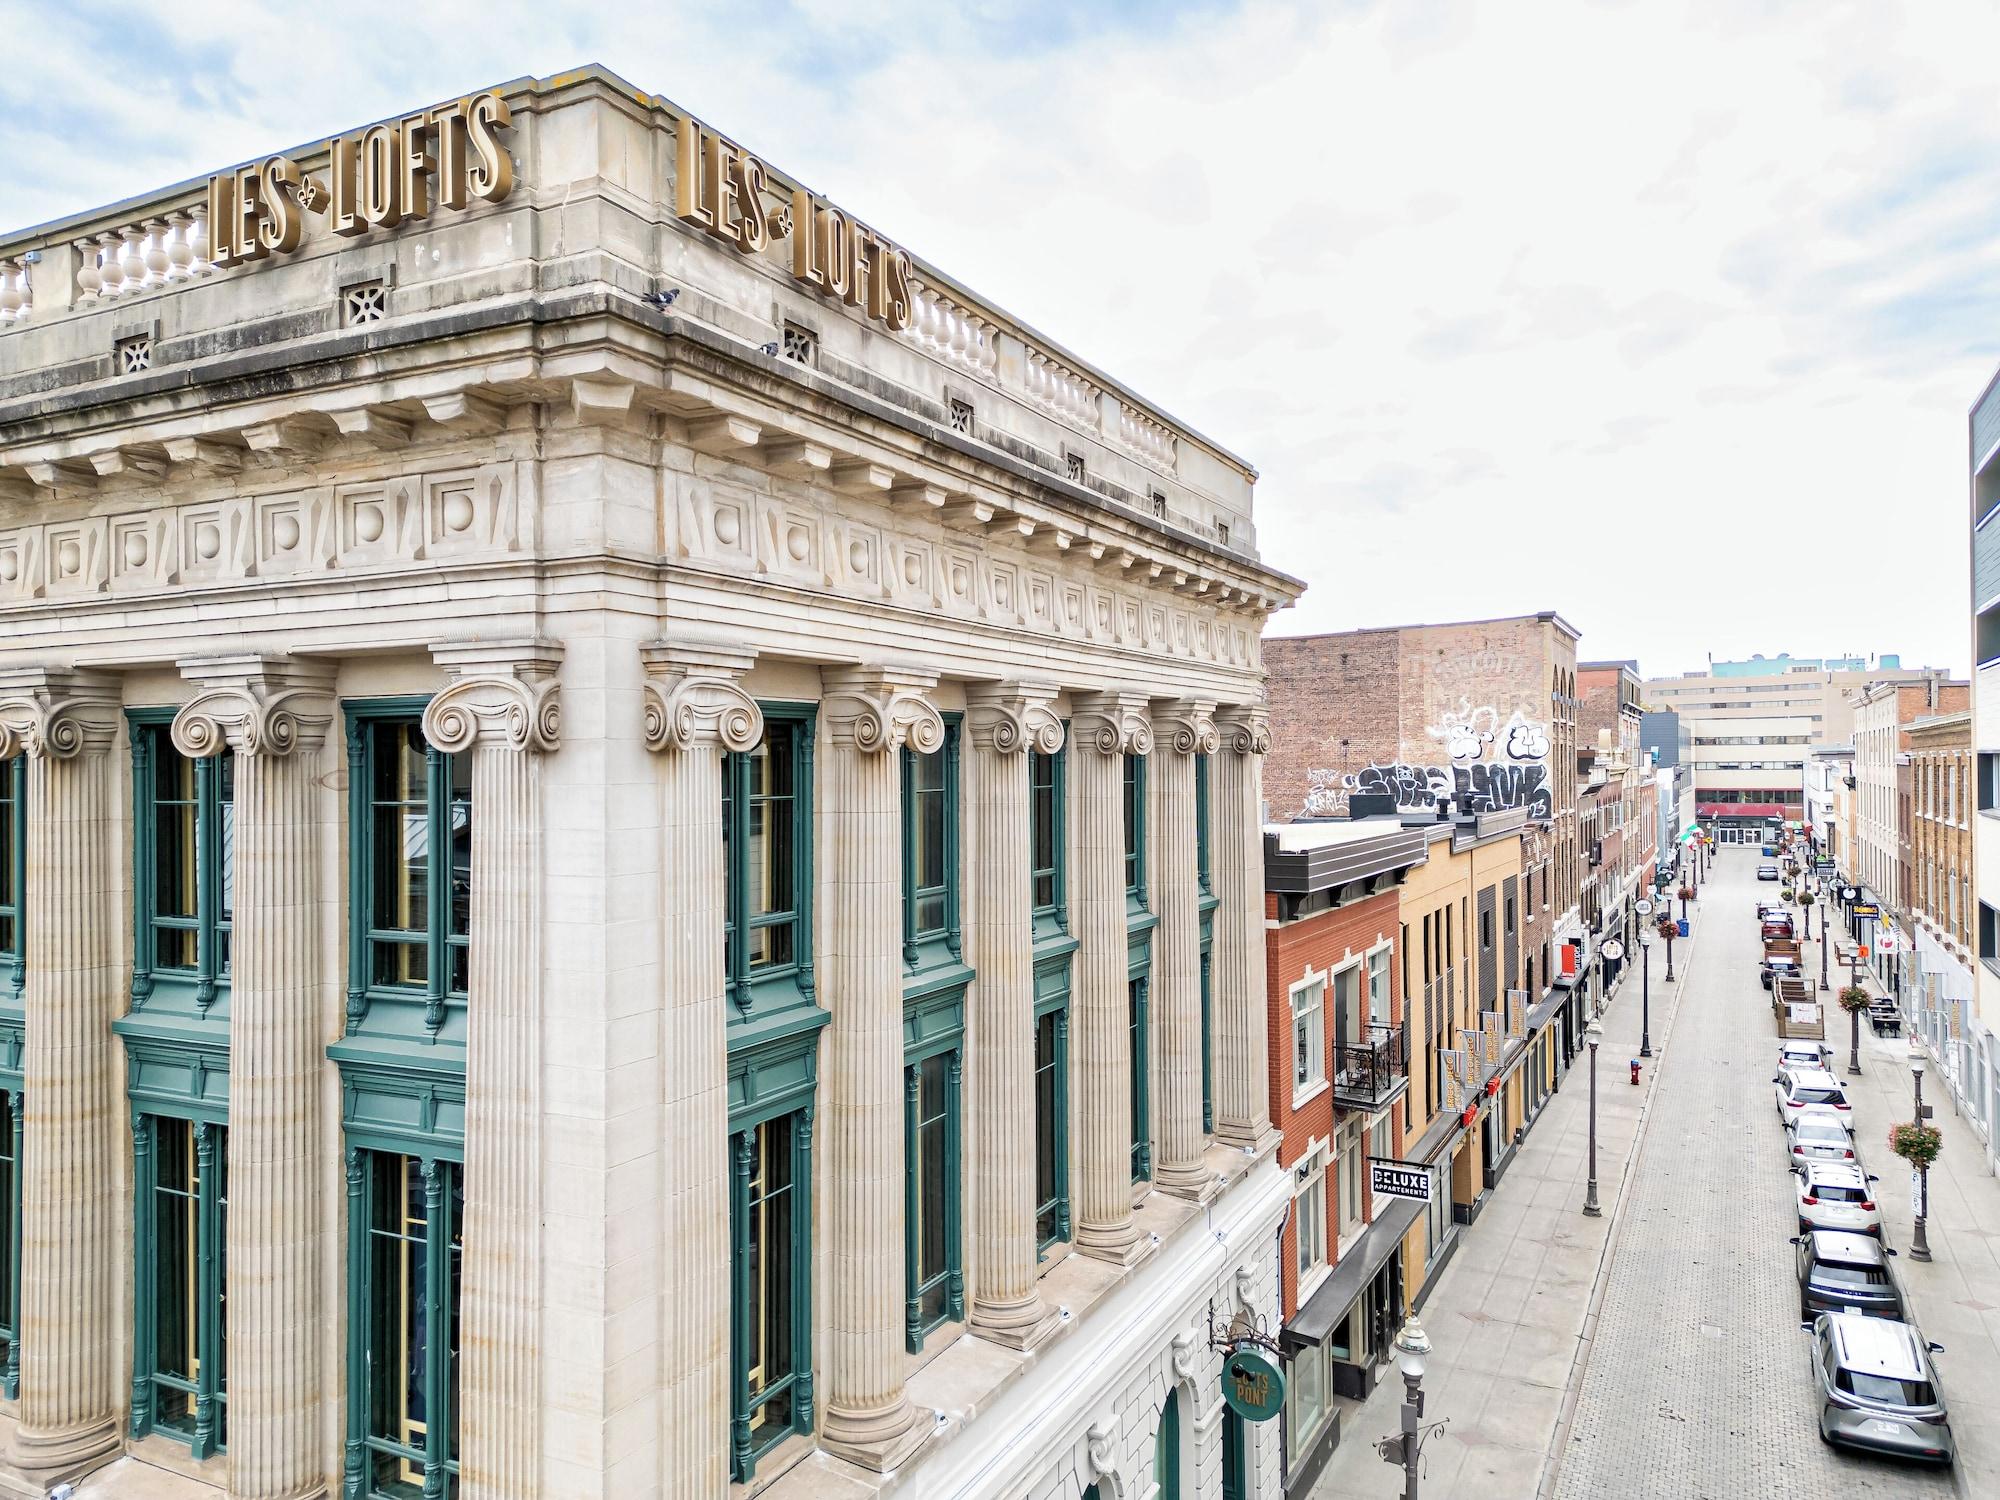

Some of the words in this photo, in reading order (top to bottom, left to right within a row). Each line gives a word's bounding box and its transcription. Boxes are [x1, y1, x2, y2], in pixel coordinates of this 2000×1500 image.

[208, 155, 300, 268] LES
[330, 92, 512, 237] LOFTS
[677, 117, 768, 254] LES
[793, 190, 912, 331] LOFTS
[1374, 1170, 1428, 1189] DELUXE
[1375, 1184, 1428, 1197] APPARTEMENTS
[1237, 1384, 1268, 1408] PONT
